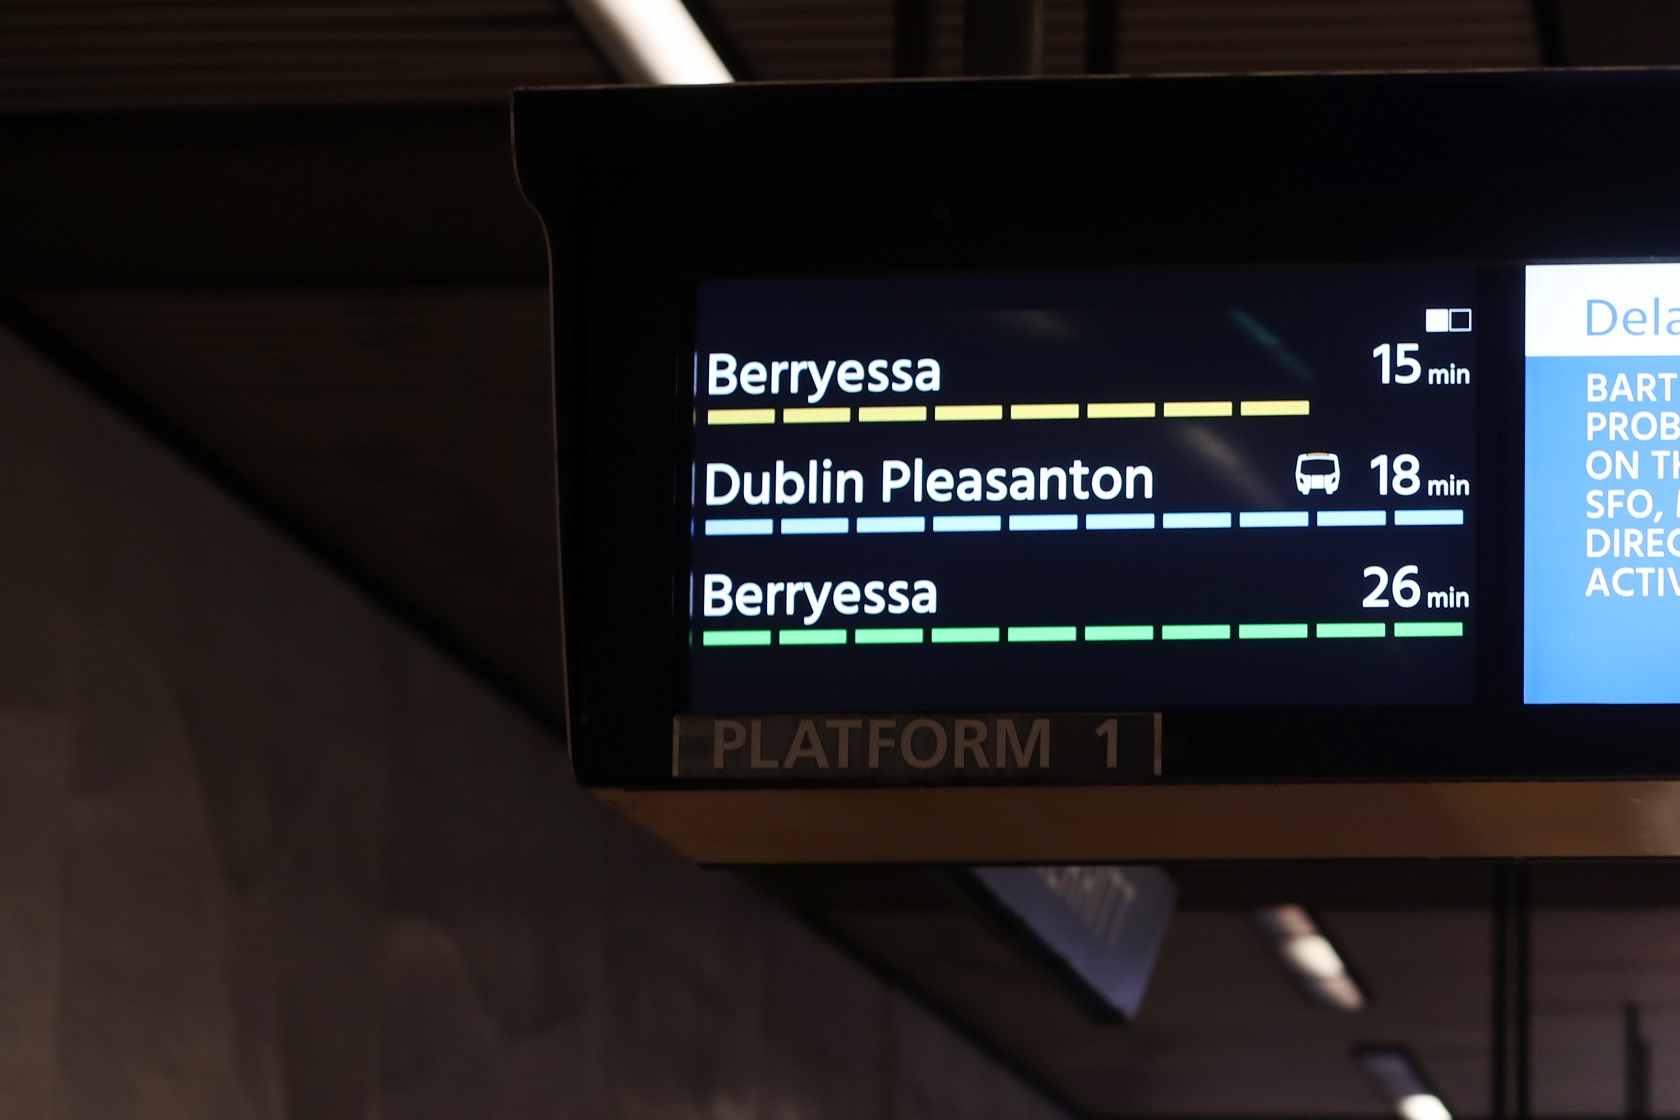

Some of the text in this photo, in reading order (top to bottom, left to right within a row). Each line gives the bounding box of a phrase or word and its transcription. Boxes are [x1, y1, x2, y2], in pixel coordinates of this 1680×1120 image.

[709, 343, 1470, 403] Berryessa 15 min
[1588, 373, 1677, 402] BART
[706, 454, 1469, 505] Dublin Pleasanton 18 min
[1586, 451, 1638, 479] ON
[1587, 489, 1663, 523] SFO,
[704, 565, 1469, 625] Berryessa 26 min
[713, 718, 1118, 769] PLATFORM 1
